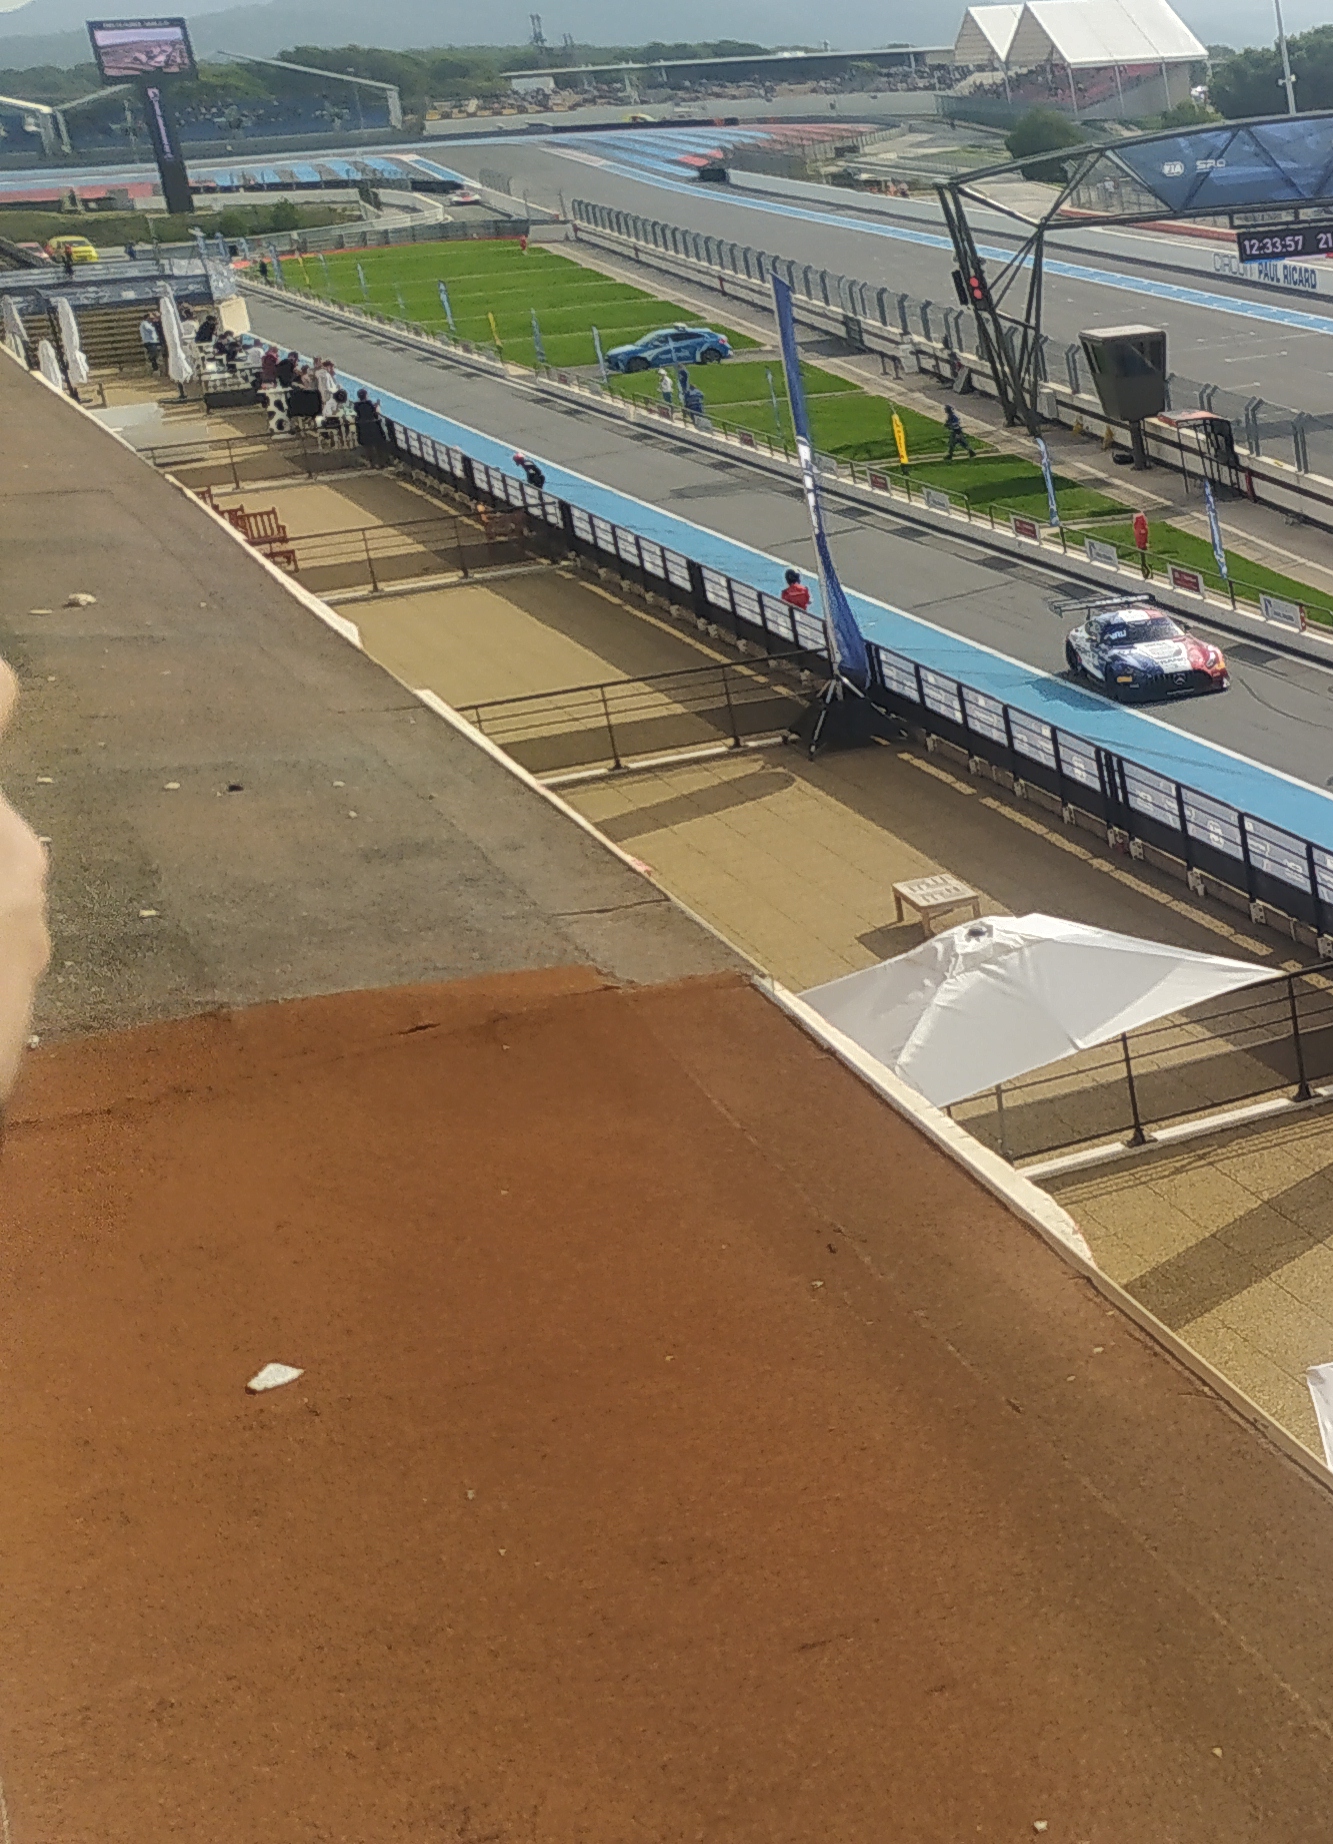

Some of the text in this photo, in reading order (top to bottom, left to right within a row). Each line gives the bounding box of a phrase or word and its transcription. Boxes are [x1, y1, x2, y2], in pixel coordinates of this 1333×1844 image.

[1244, 235, 1304, 255] 12:33:57
[1257, 262, 1281, 284] PAUL
[1282, 265, 1318, 290] RICARD
